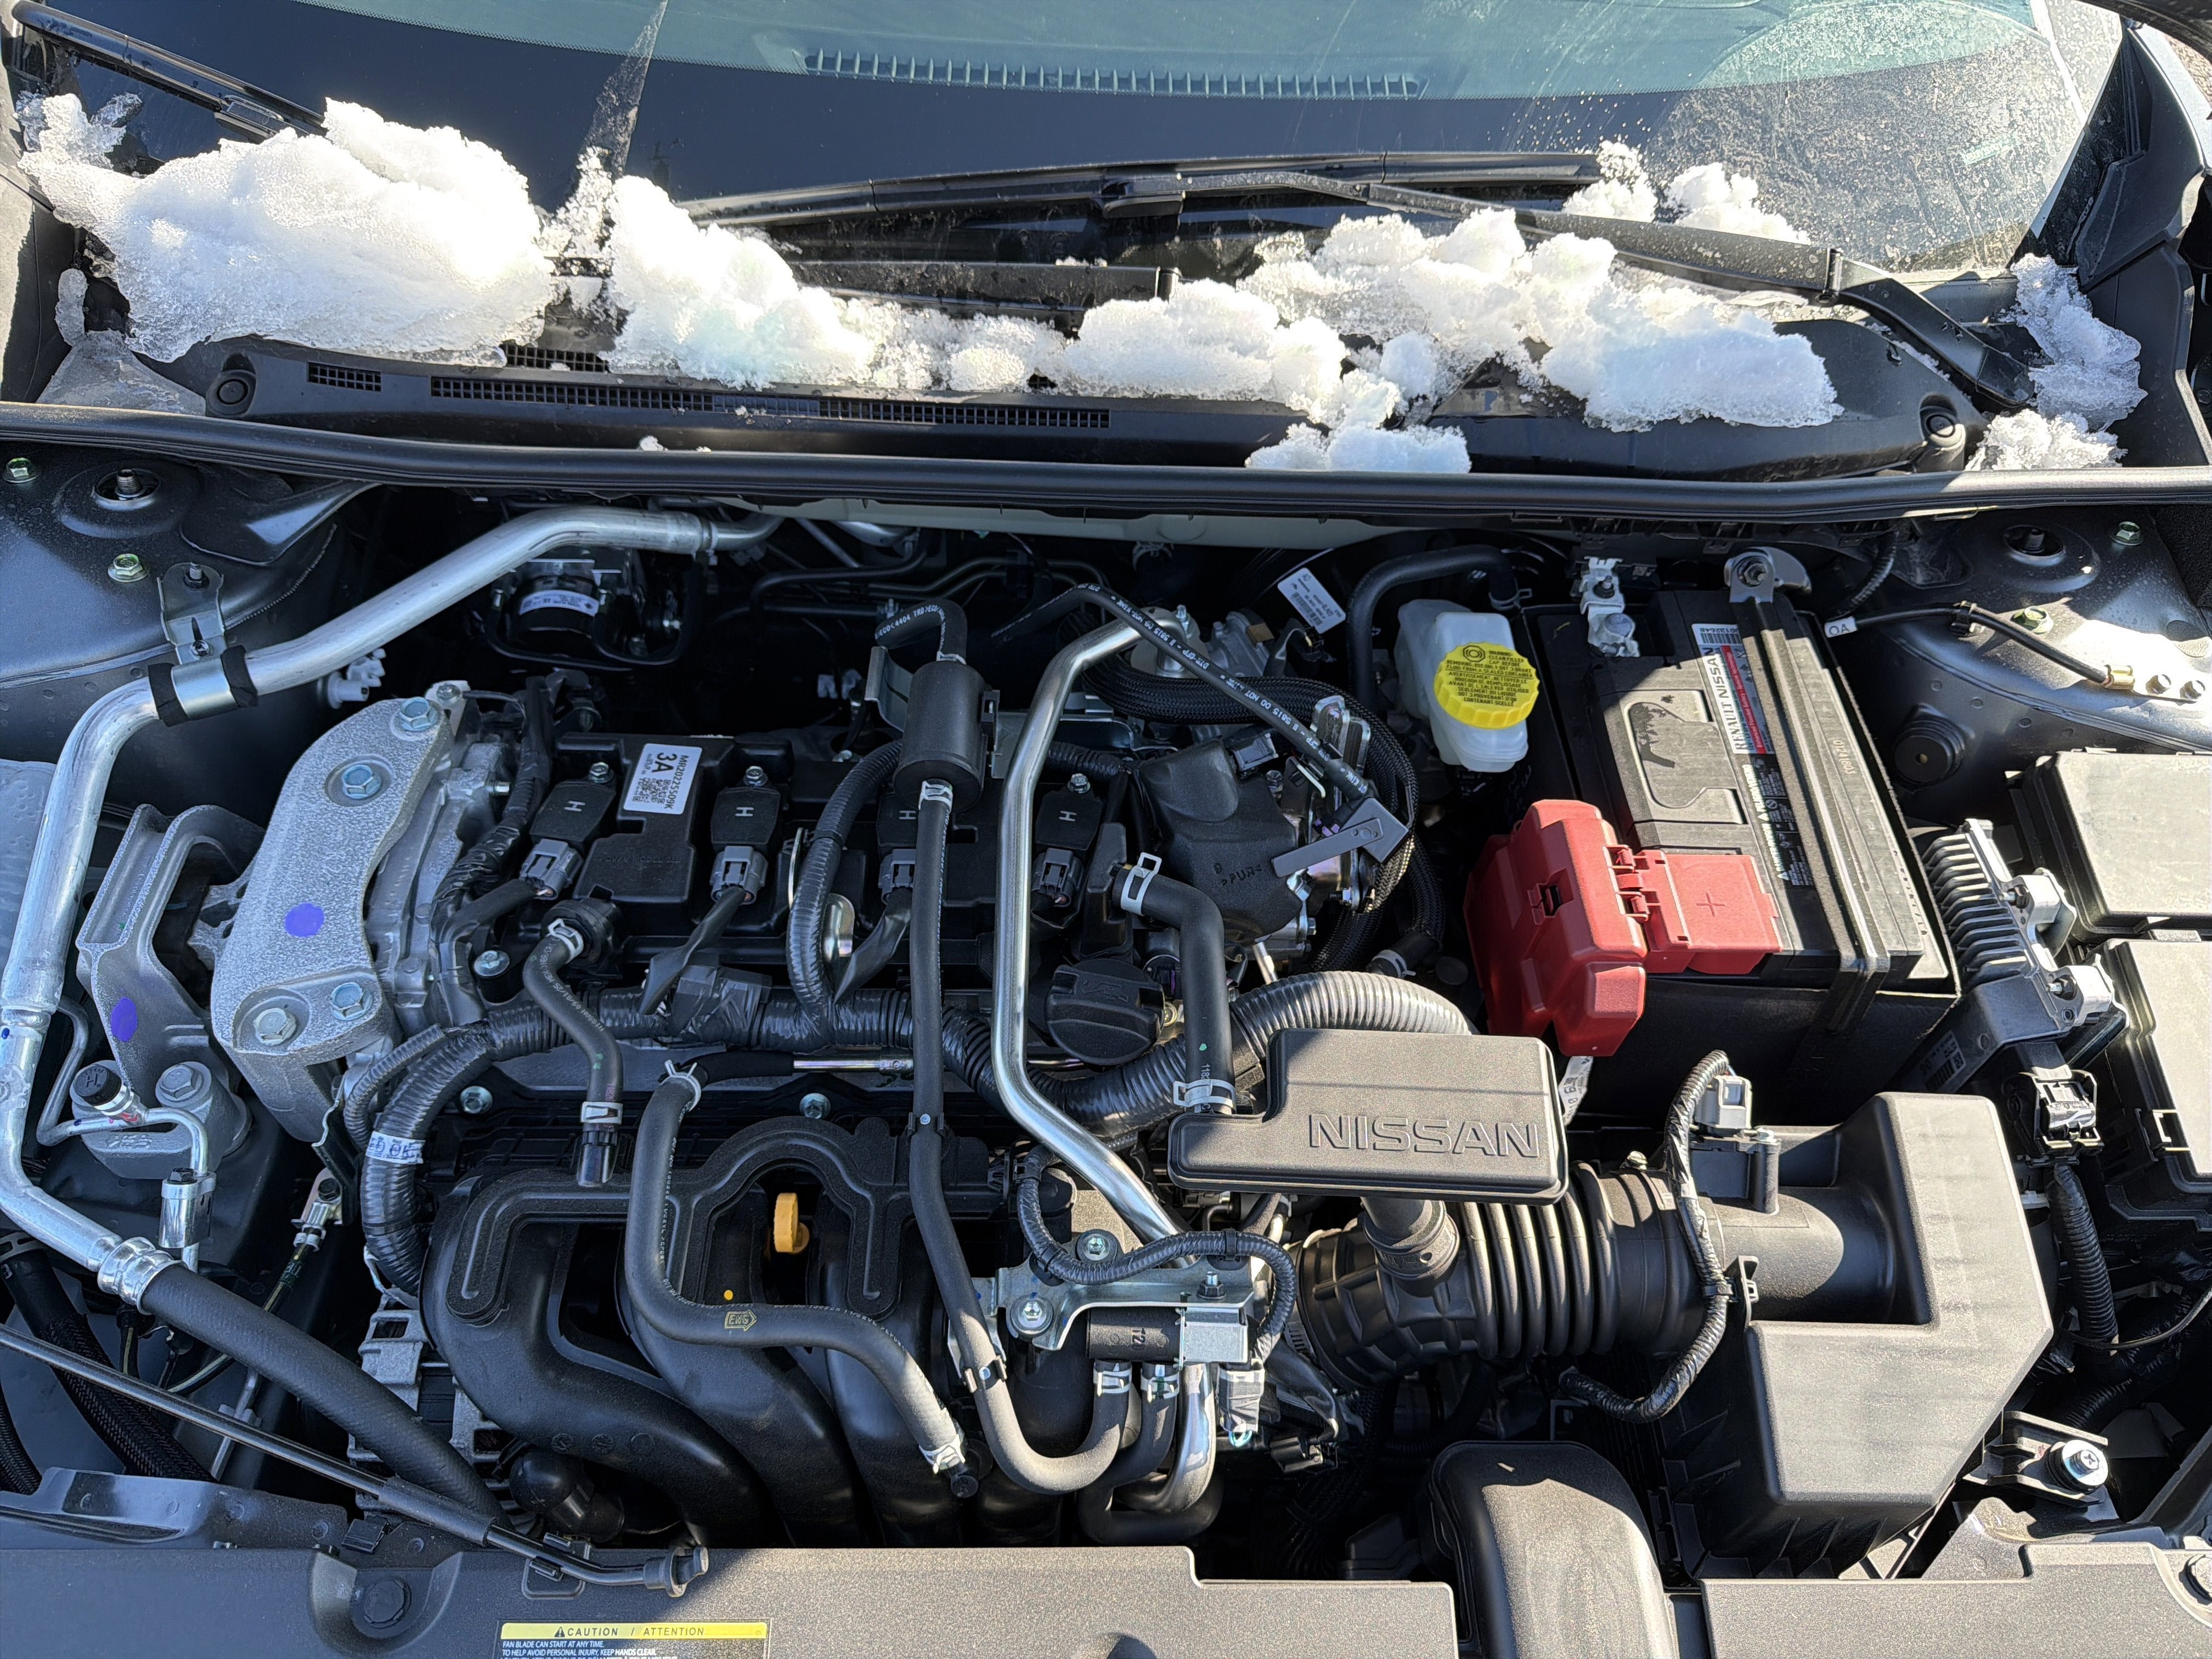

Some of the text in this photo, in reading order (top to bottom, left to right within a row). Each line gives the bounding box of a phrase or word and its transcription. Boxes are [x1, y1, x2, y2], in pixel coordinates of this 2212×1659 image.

[1153, 627, 1170, 641] 5815
[1702, 647, 1729, 698] NISSAN
[1486, 680, 1522, 688] REMPLISSAGE
[1245, 690, 1260, 702] NOT
[1273, 708, 1291, 725] 5815
[1721, 702, 1748, 750] RENAULT
[652, 753, 677, 773] 3A
[664, 755, 689, 809] MR20225509K
[565, 800, 586, 812] H
[735, 807, 754, 816] H
[899, 810, 917, 820] H
[1059, 810, 1077, 822] H
[543, 970, 555, 983] MEX
[581, 1009, 605, 1032] NISSAN
[1309, 1114, 1540, 1158] NISSAN
[567, 1627, 618, 1637] CAUTION
[643, 1627, 704, 1636] ATTENTION
